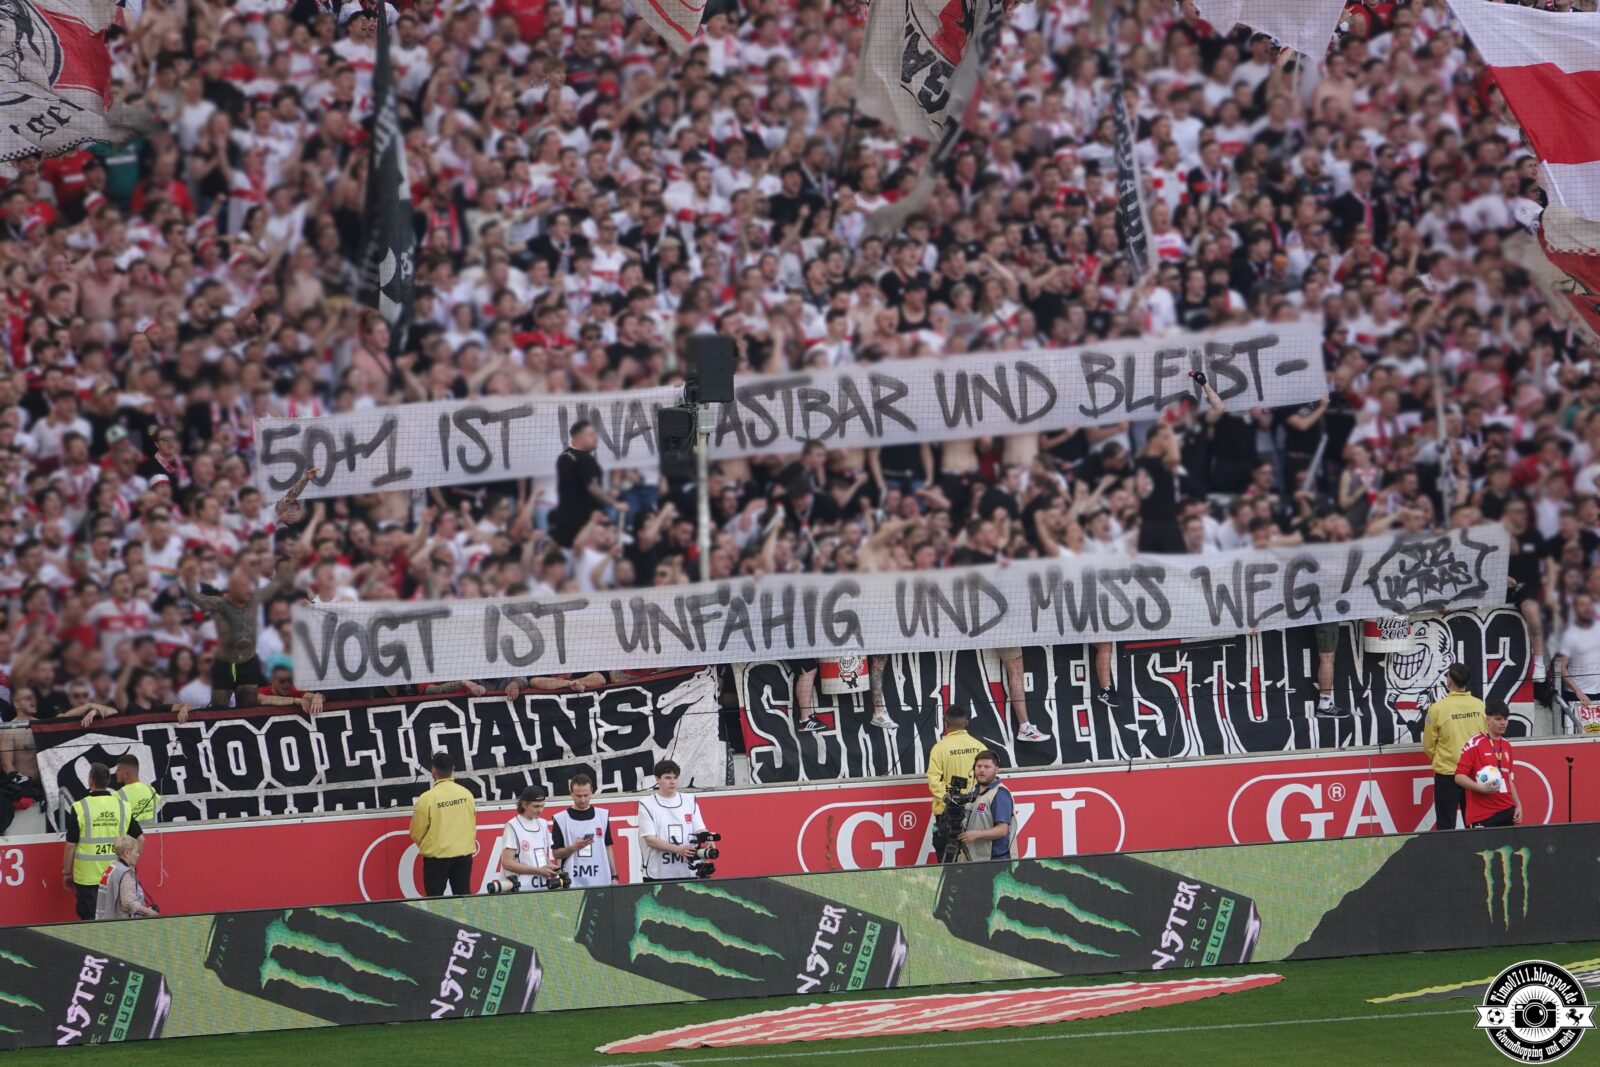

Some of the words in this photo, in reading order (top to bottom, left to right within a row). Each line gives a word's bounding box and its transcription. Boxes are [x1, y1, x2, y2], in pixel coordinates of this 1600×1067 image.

[261, 413, 412, 491] 50+1
[438, 403, 535, 474] IST
[558, 372, 918, 460] UNAASTBAR
[933, 360, 1058, 429] UND
[296, 606, 450, 681] VOGT
[484, 598, 589, 667] IST
[610, 578, 865, 654] UNFÄHIG
[896, 570, 1008, 639] UND
[1027, 563, 1172, 636] MUSS
[138, 687, 655, 797] HOOLIGANS
[1451, 711, 1480, 721] SECURITY
[949, 747, 980, 756] SECURITY
[437, 798, 467, 808] SECURITY
[0, 848, 25, 887] 3
[573, 864, 600, 878] SMF
[851, 923, 880, 989] SUGAR
[1205, 899, 1232, 965] SUGAR
[113, 974, 141, 1040] SUGAR
[486, 947, 513, 1014] SUGAR
